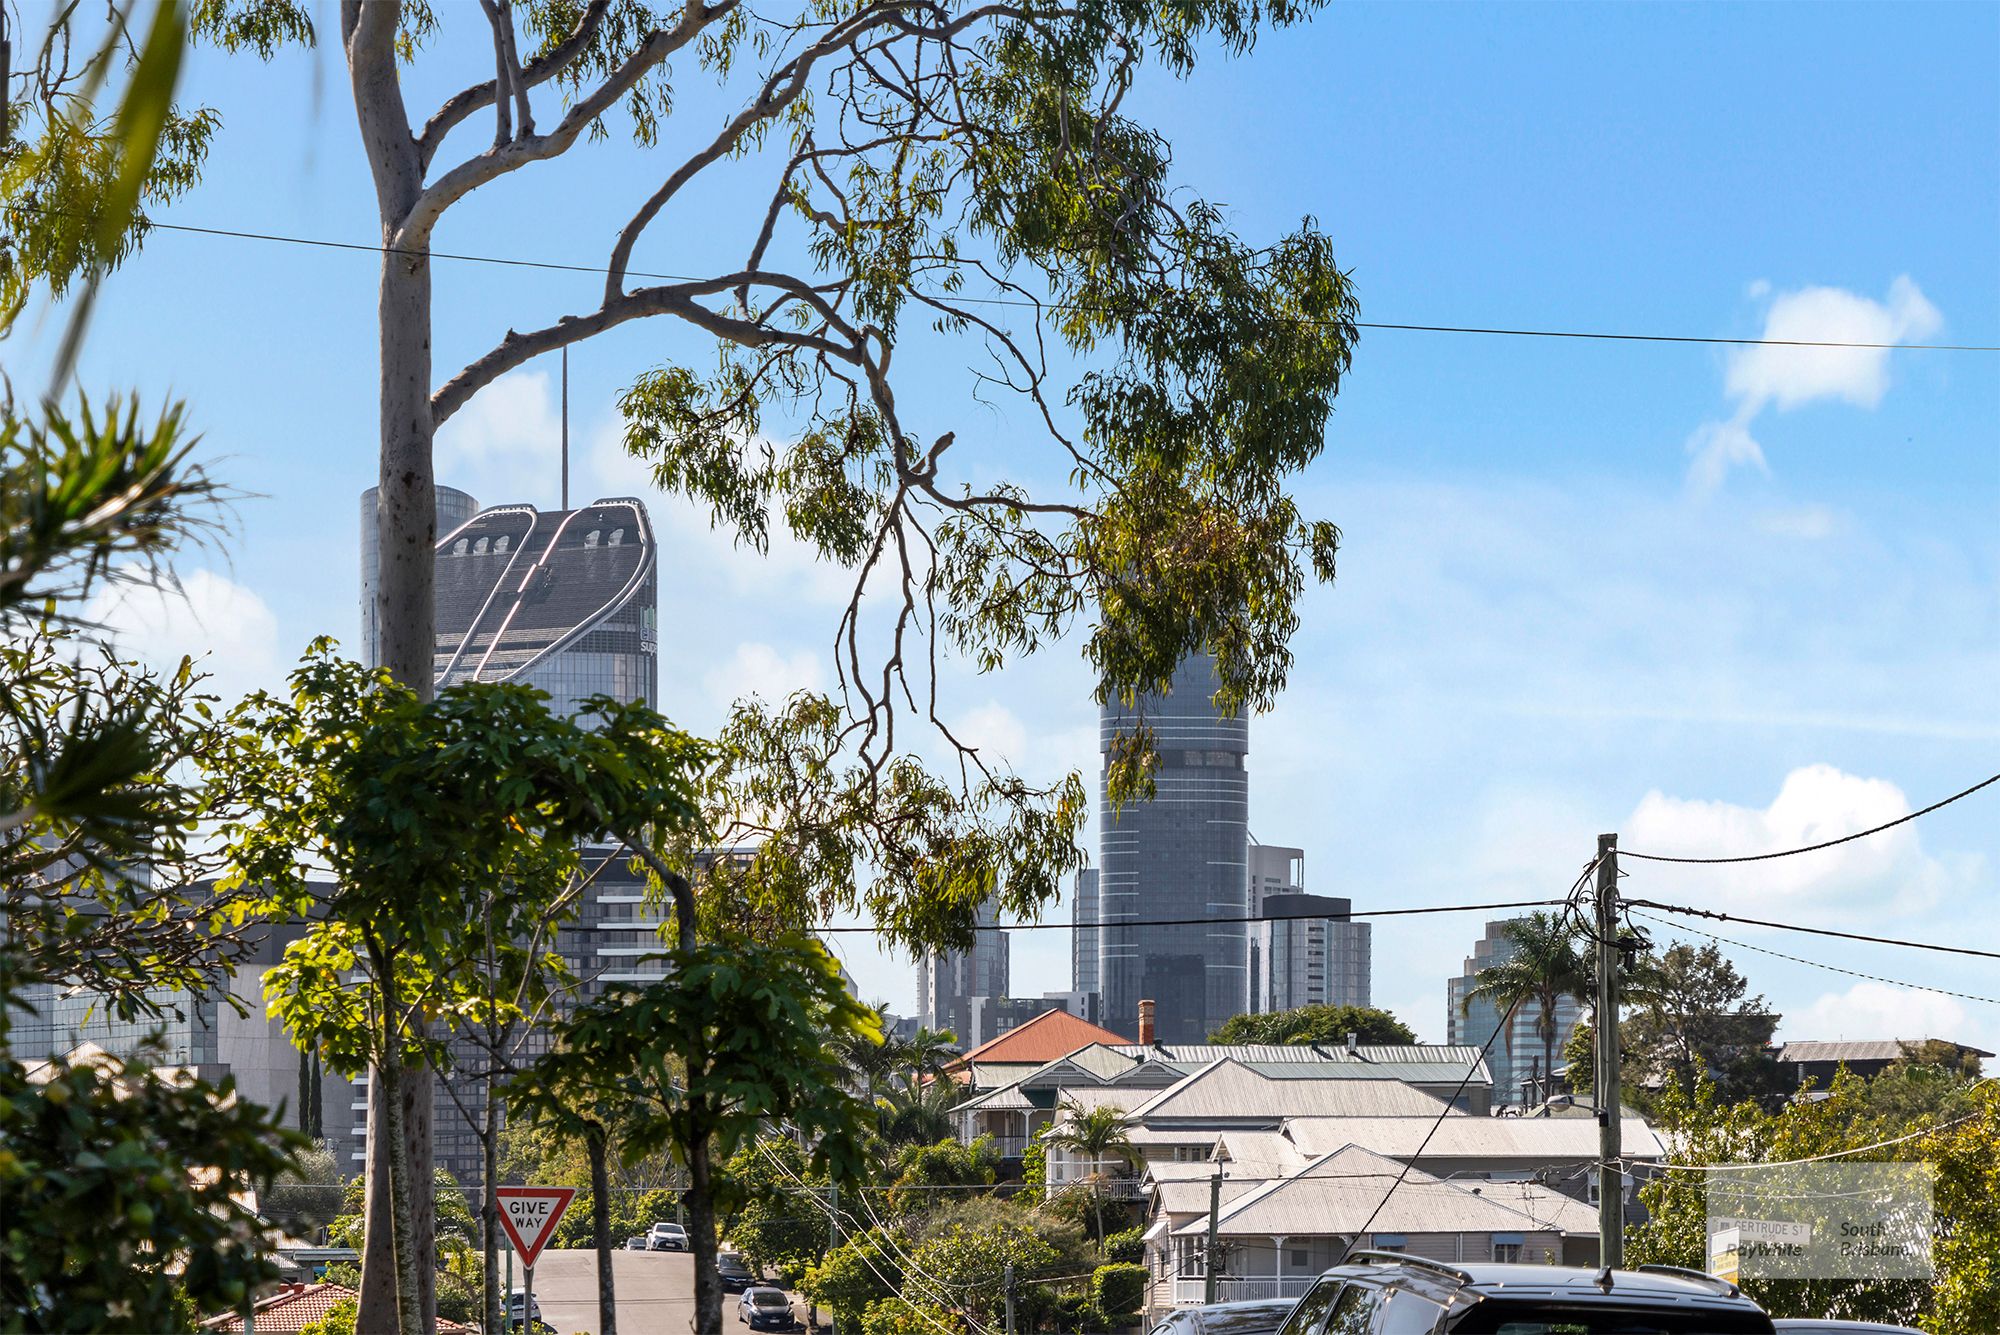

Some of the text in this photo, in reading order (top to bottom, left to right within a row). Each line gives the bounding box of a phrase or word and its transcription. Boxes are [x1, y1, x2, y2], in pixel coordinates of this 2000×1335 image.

[509, 1201, 548, 1214] GIVE
[515, 1217, 542, 1228] WAY
[1734, 1220, 1788, 1234] GERTRUDE
